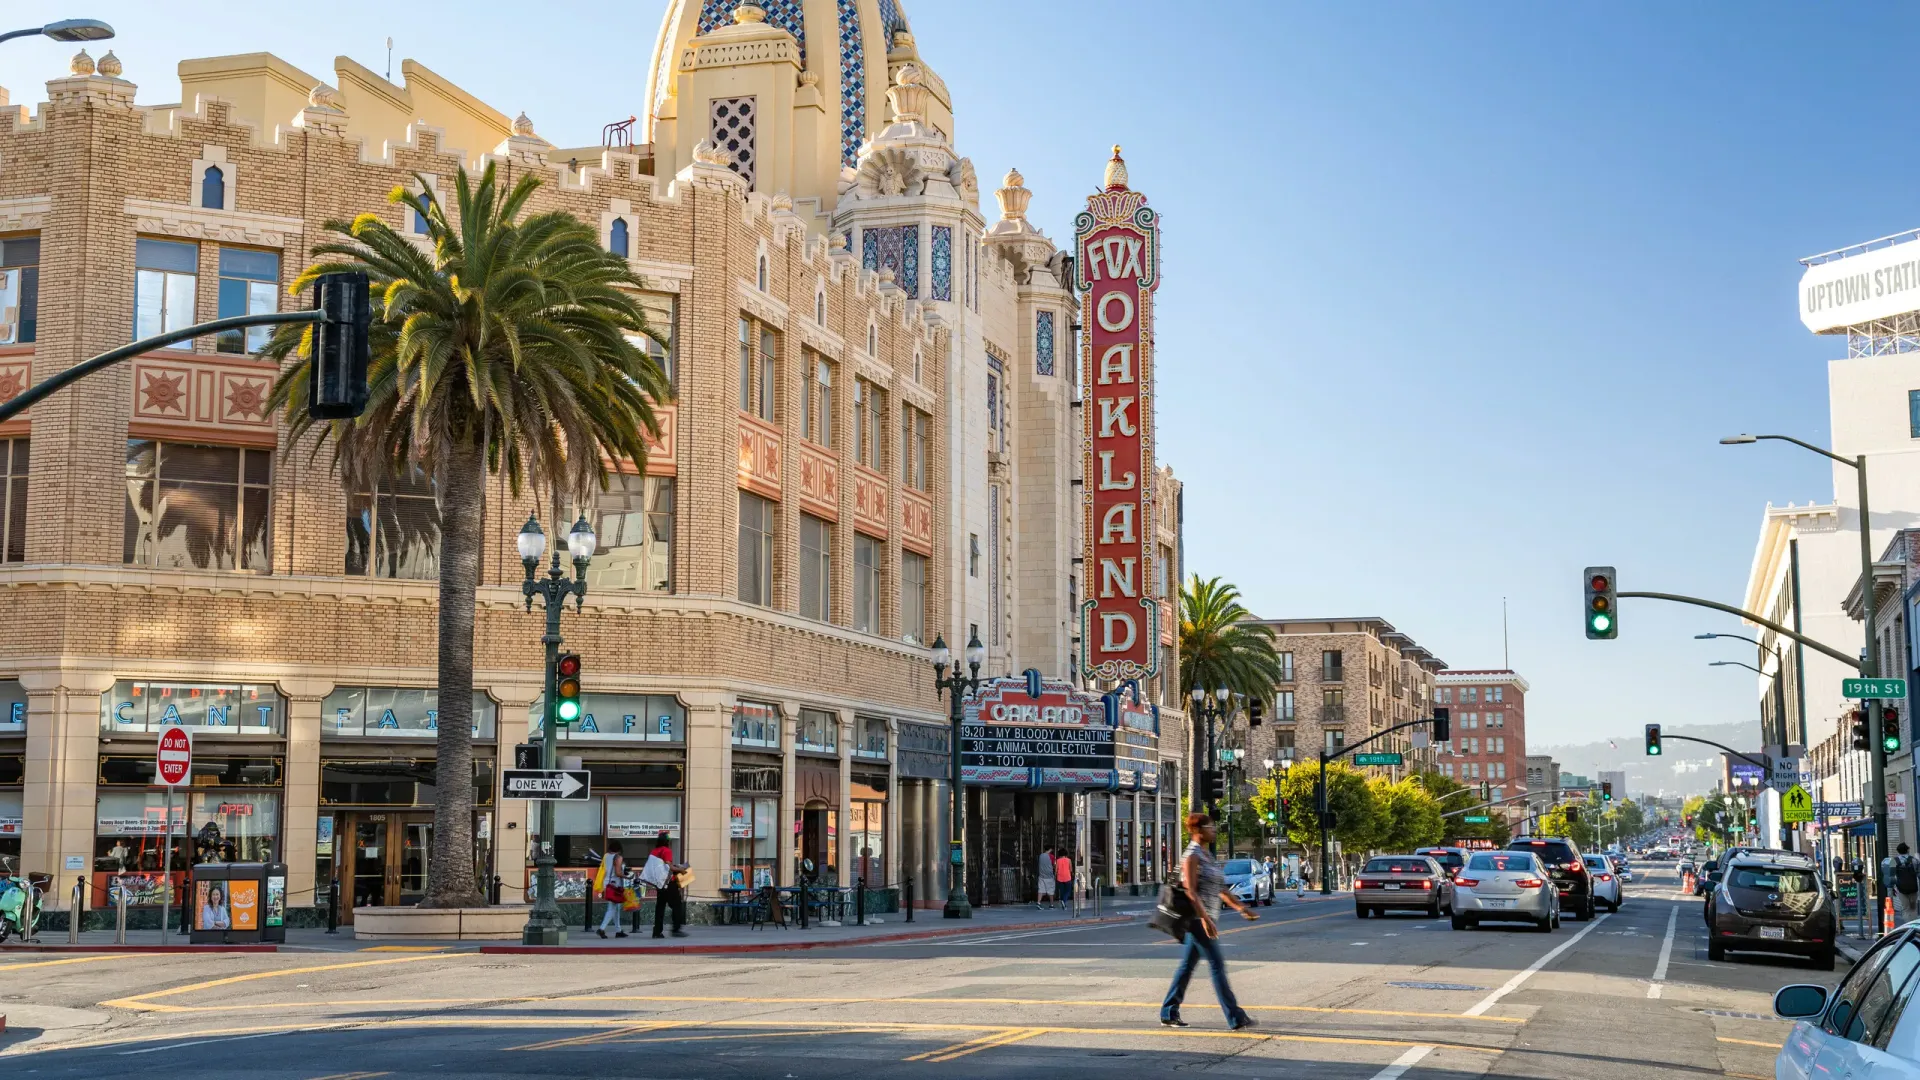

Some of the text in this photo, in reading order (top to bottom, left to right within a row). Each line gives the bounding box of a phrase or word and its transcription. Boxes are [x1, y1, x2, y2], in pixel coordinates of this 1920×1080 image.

[1086, 235, 1143, 281] FOX
[1807, 272, 1871, 313] UPTOWN
[1097, 290, 1138, 653] OAKLAND
[1848, 683, 1900, 694] 19th St
[114, 702, 272, 726] CAN'T
[337, 708, 478, 731] FAI
[990, 704, 1083, 724] OAKLAND
[996, 728, 1011, 739] MY
[1014, 728, 1055, 740] BLOODY
[1059, 730, 1112, 742] VALENTINE
[164, 738, 187, 748] DO NOT
[972, 741, 985, 752] 30
[996, 741, 1033, 753] ANIMAL
[1036, 743, 1096, 755] COLLECTIVE
[978, 755, 985, 766] 3
[996, 756, 1024, 767] TOTO
[1779, 762, 1792, 770] NO
[164, 763, 183, 774] ENTER
[515, 780, 563, 790] ONE WAY
[220, 804, 253, 816] OPEN
